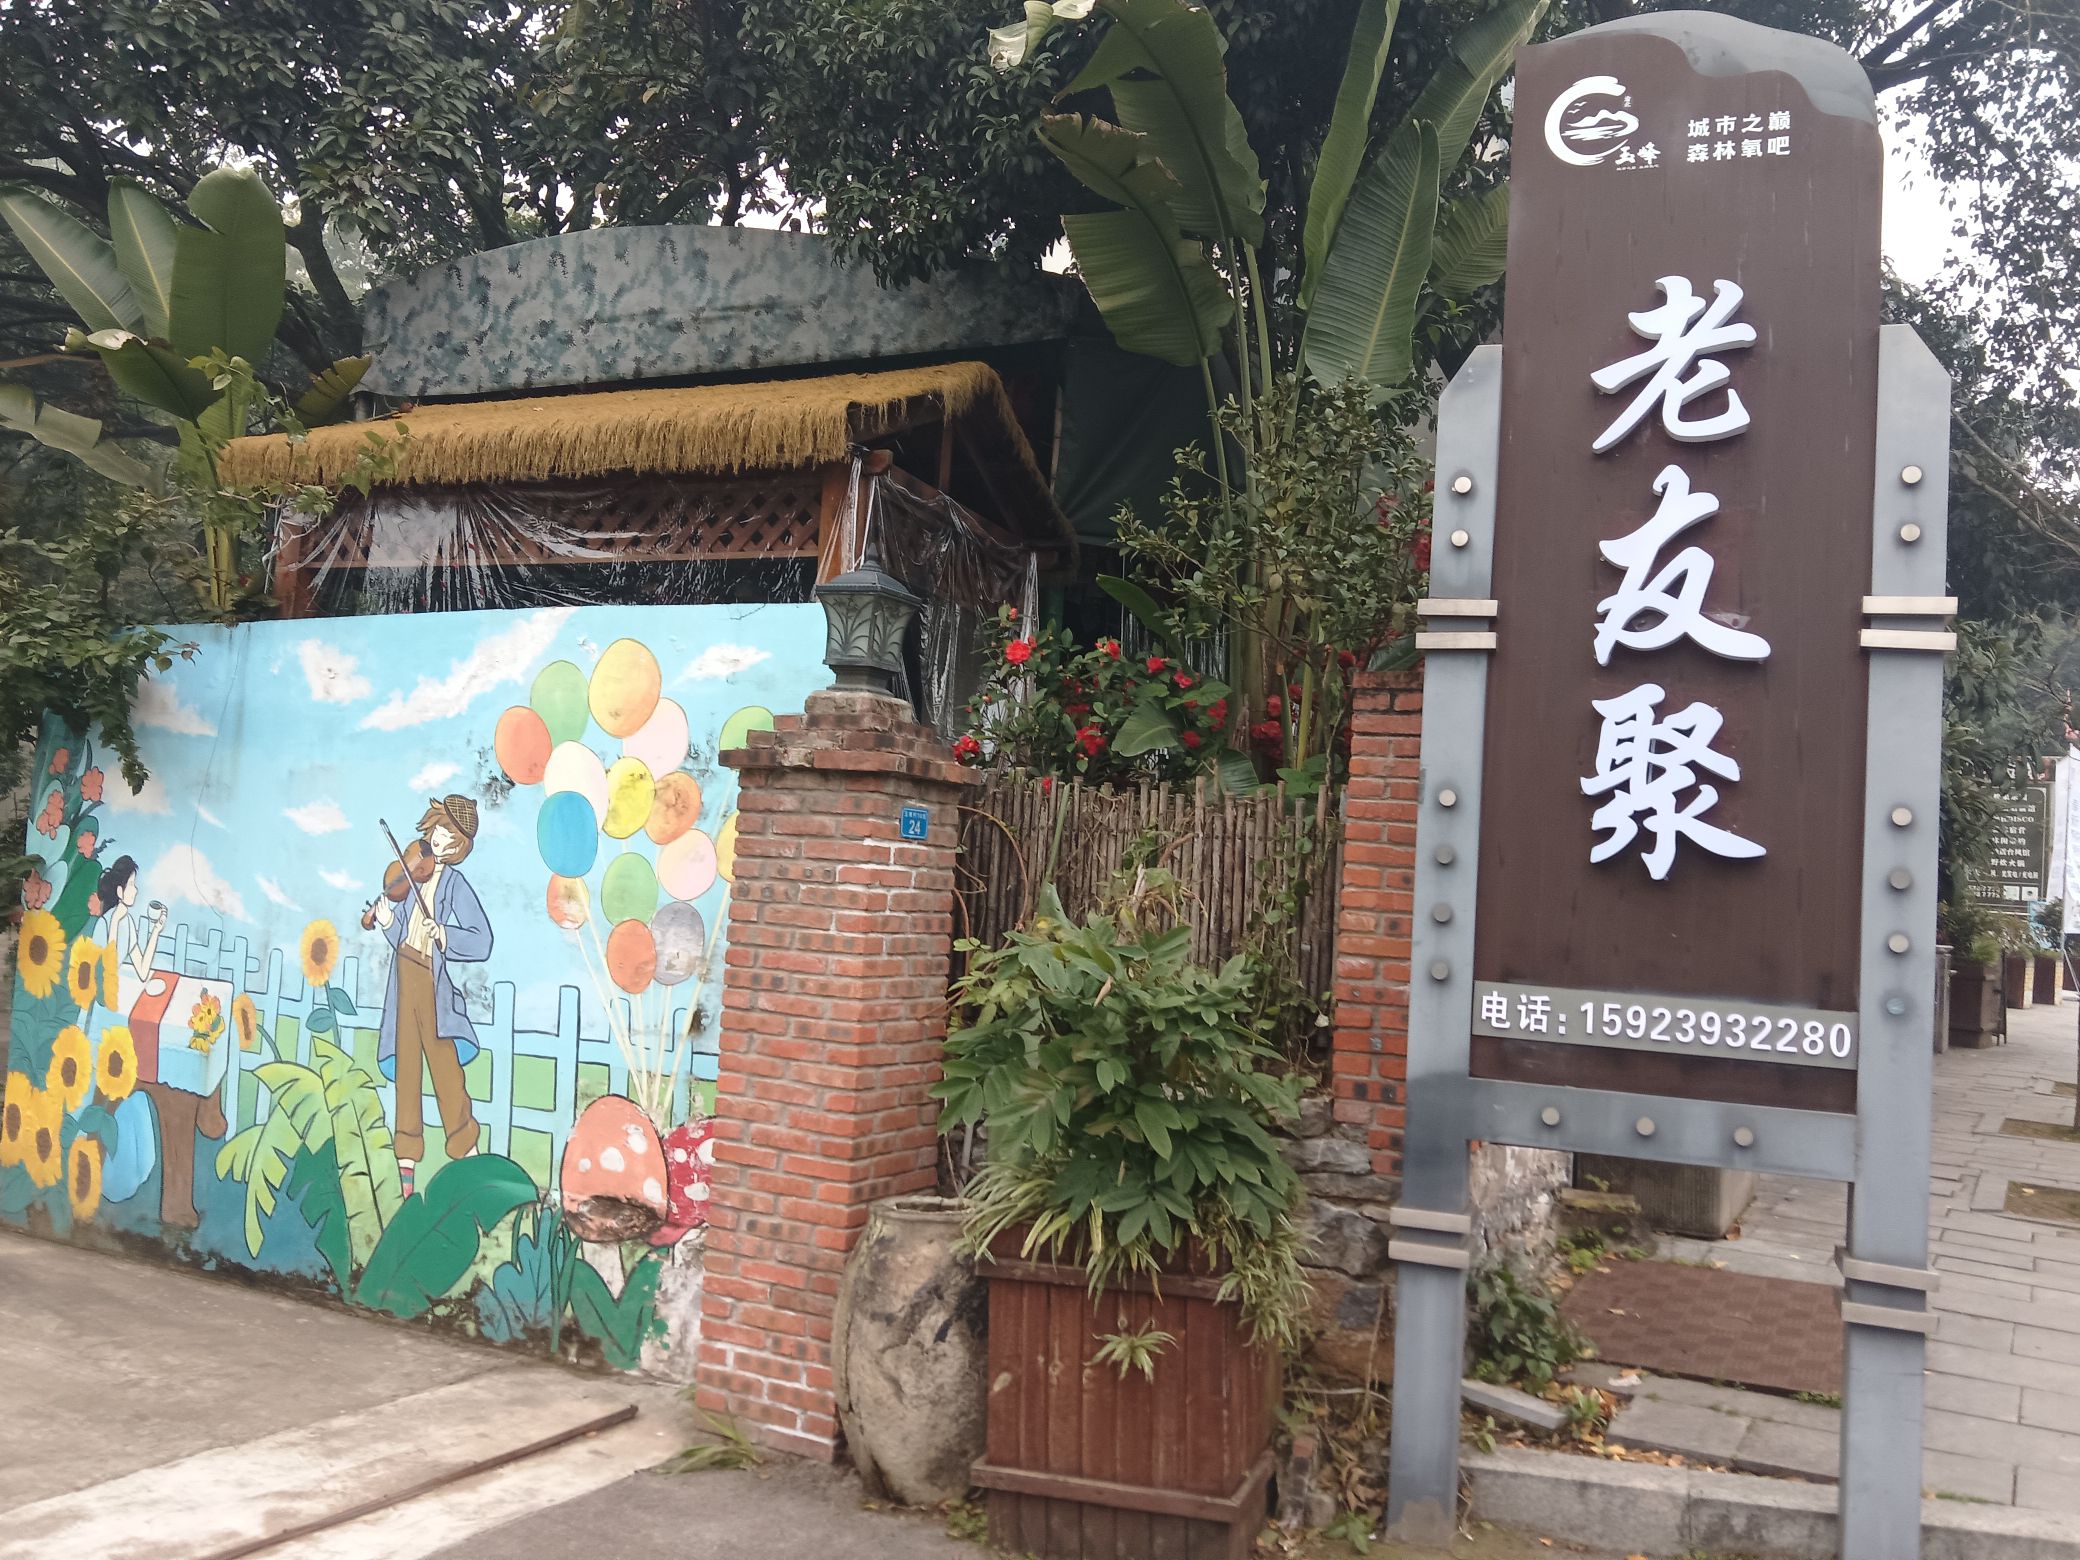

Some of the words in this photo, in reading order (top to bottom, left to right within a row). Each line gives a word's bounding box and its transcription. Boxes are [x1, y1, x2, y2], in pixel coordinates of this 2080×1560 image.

[1687, 111, 1790, 137] 城市之巅
[1686, 136, 1790, 162] 森林氧吧
[1580, 275, 1771, 881] 老友聚
[908, 819, 921, 835] 24
